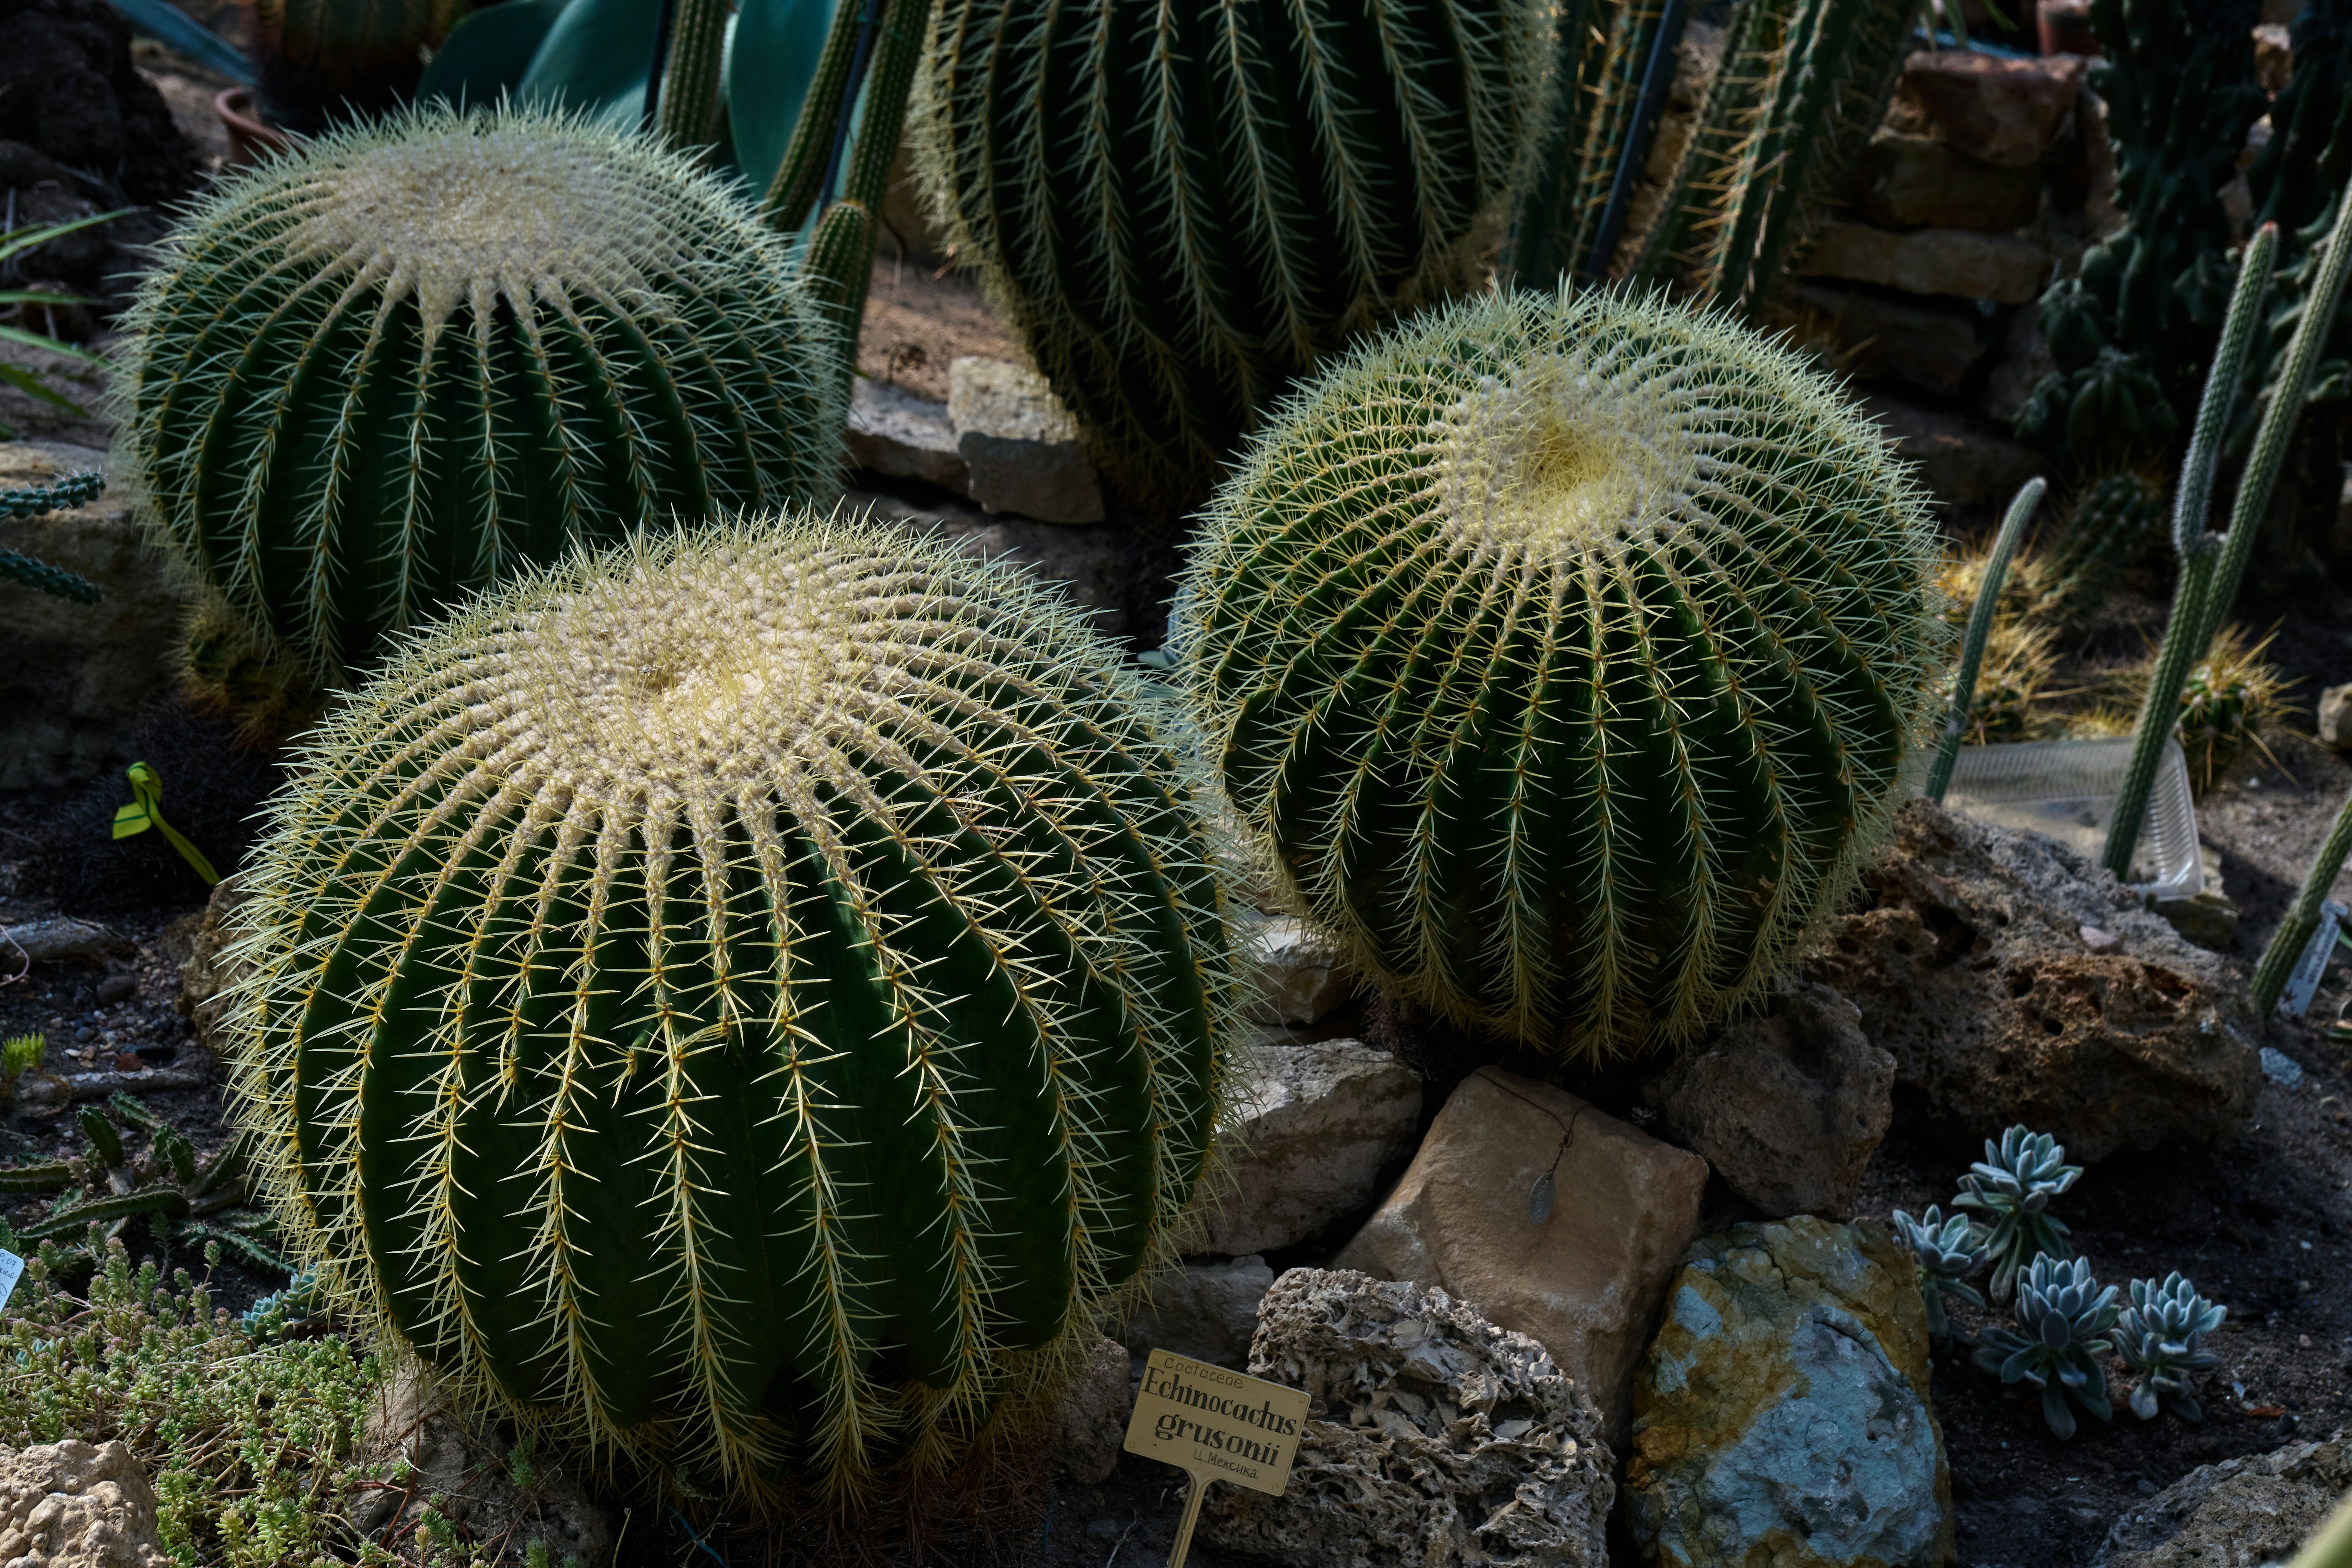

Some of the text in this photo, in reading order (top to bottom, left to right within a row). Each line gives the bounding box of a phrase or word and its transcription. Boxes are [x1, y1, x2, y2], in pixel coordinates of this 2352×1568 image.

[1165, 1358, 1243, 1388] Cactaceae
[1142, 1366, 1297, 1435] Echinocactus
[1155, 1414, 1280, 1466] grusonii
